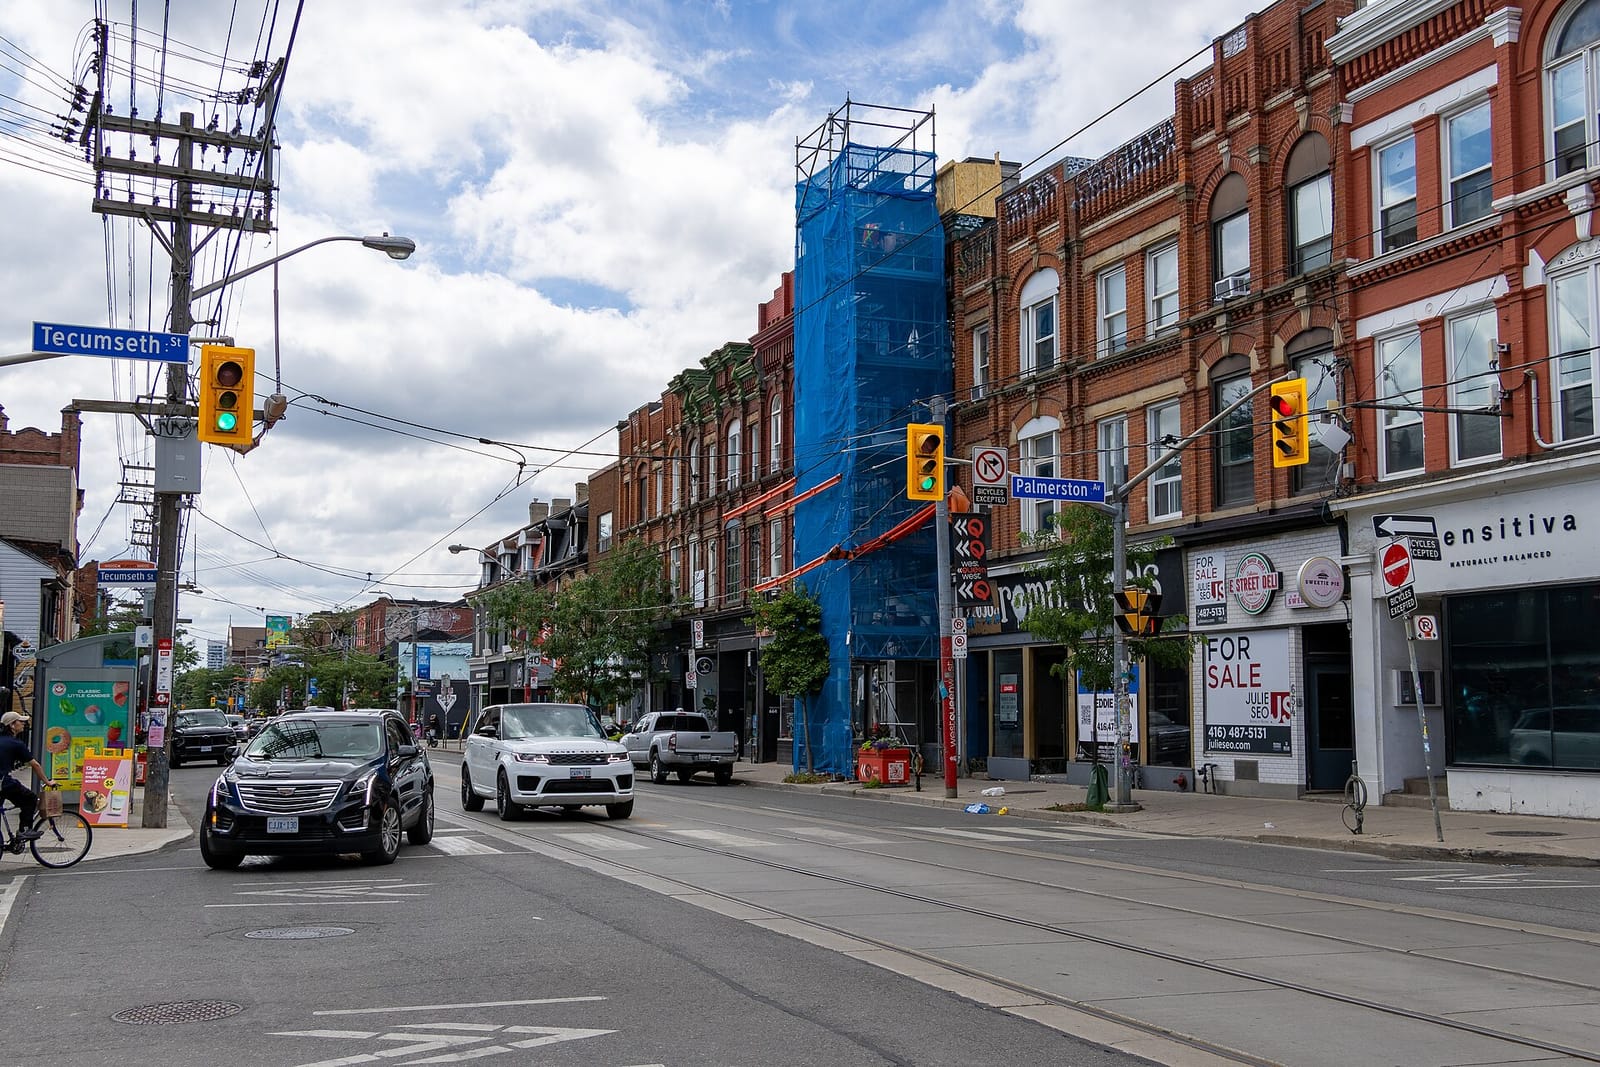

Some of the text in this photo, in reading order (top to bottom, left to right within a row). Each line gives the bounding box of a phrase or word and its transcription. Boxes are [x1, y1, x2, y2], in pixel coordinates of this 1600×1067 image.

[41, 326, 182, 354] Tecumseth St
[976, 487, 1005, 496] BICYCLES
[1016, 478, 1101, 498] Palmerston Av
[975, 495, 1006, 504] EXCEPTED
[1443, 513, 1577, 547] ensitiva
[1411, 539, 1436, 549] CYCLES
[1412, 548, 1439, 558] CEPTED
[1450, 550, 1551, 568] NATURALLY BALANCED
[960, 560, 980, 568] west
[1196, 556, 1214, 568] FOR
[100, 571, 145, 581] Tecumseth
[961, 572, 982, 580] west
[1195, 568, 1218, 580] SALE
[1196, 582, 1211, 591] JULIE
[1236, 576, 1260, 592] STREET
[1262, 574, 1278, 589] DELI
[1200, 591, 1211, 600] SEO
[1390, 589, 1411, 606] BICYCLES
[1390, 598, 1415, 616] EXCEPTED
[1207, 636, 1250, 662] FOR
[528, 655, 540, 665] 40
[1207, 663, 1262, 689] SALE
[1246, 691, 1269, 705] JULIE
[1251, 706, 1269, 719] SEO
[1208, 726, 1267, 739] 416) 487-5131
[1208, 738, 1250, 750] julieseo.com
